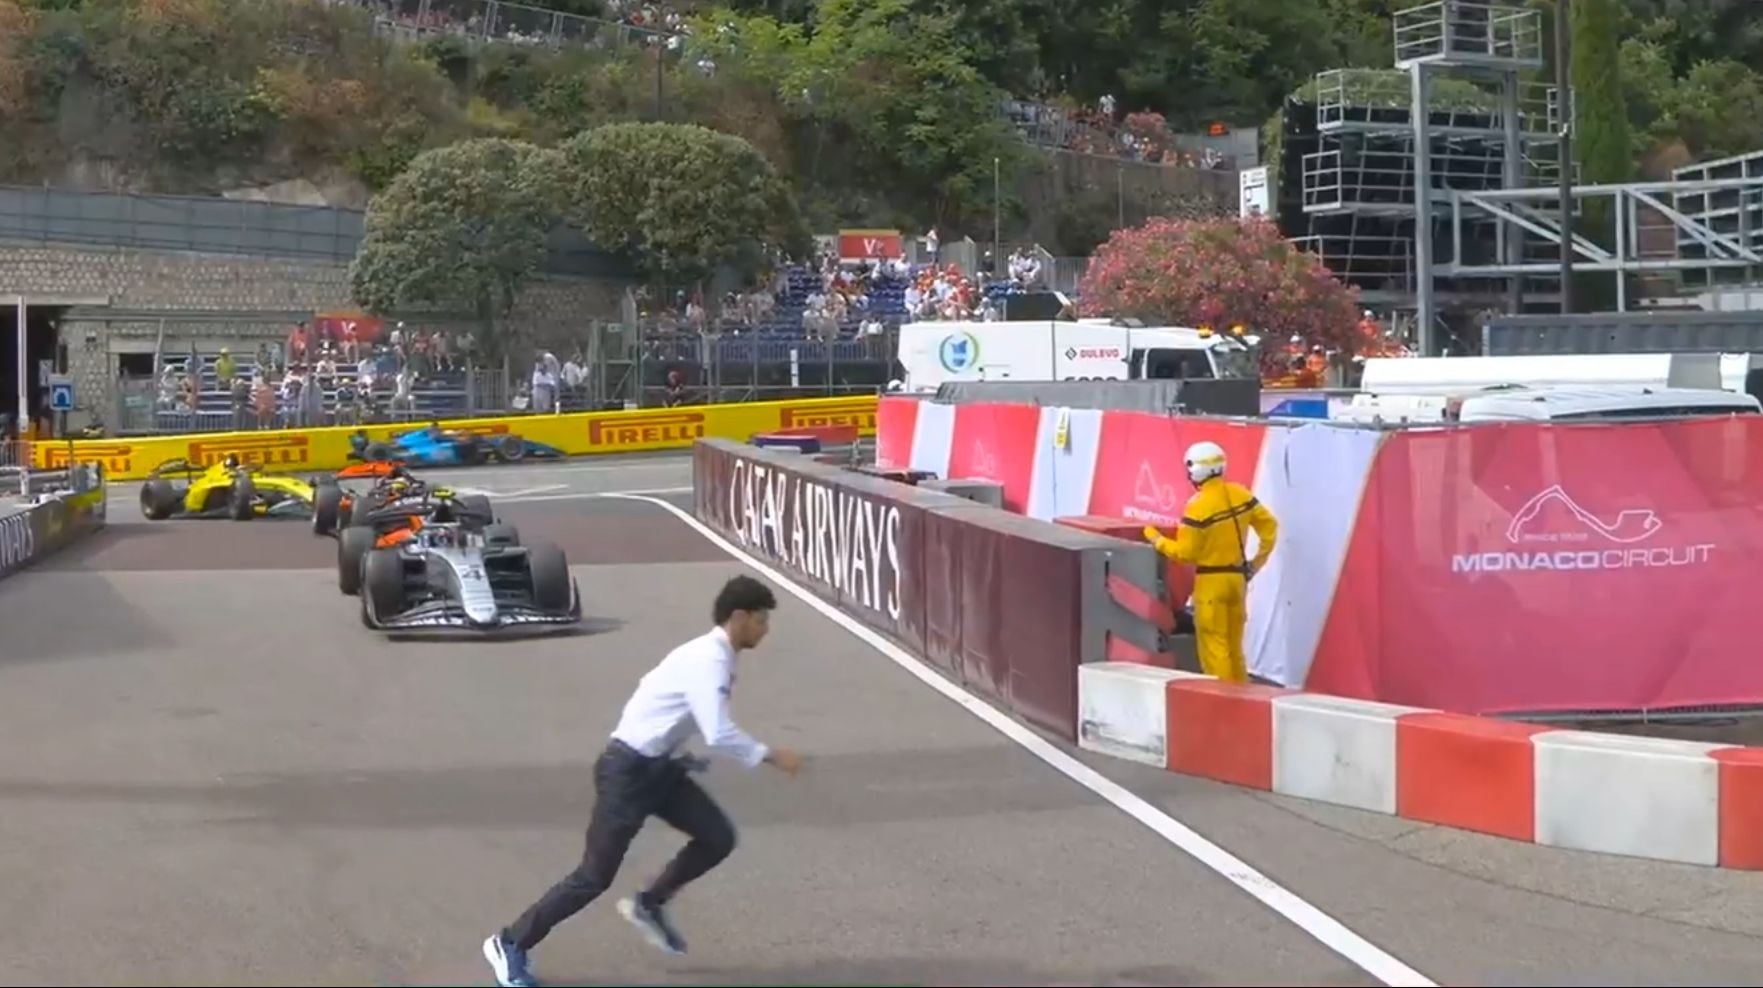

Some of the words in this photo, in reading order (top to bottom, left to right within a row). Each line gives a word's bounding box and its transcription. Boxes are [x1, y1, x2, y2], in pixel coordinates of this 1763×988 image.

[1079, 348, 1119, 359] DULEVO
[587, 403, 704, 445] PIRELLI
[780, 403, 877, 432] PIRELL
[188, 436, 309, 466] PIELLI
[730, 458, 789, 562] QATAR
[792, 477, 900, 620] AIRWAYS
